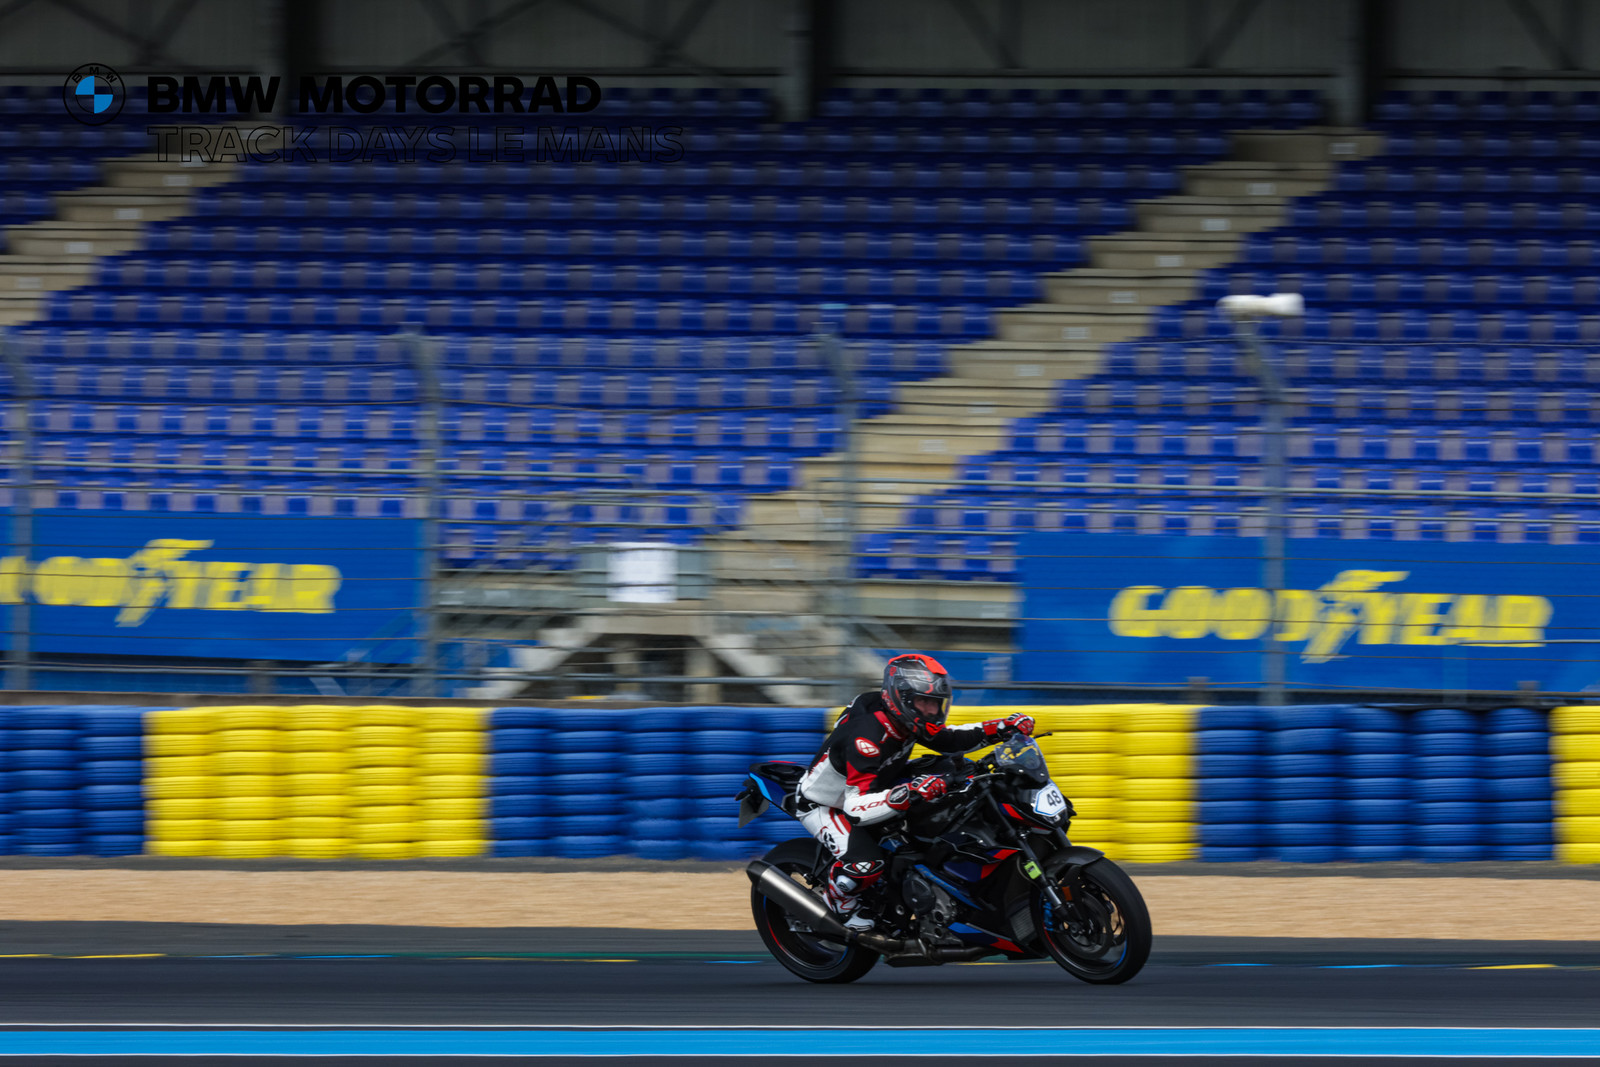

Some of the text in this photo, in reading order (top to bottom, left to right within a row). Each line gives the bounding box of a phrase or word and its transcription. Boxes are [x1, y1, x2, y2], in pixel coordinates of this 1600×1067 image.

[0, 538, 342, 627] OODYEAR
[1108, 569, 1554, 664] GOODYEAR
[1046, 790, 1062, 807] 48
